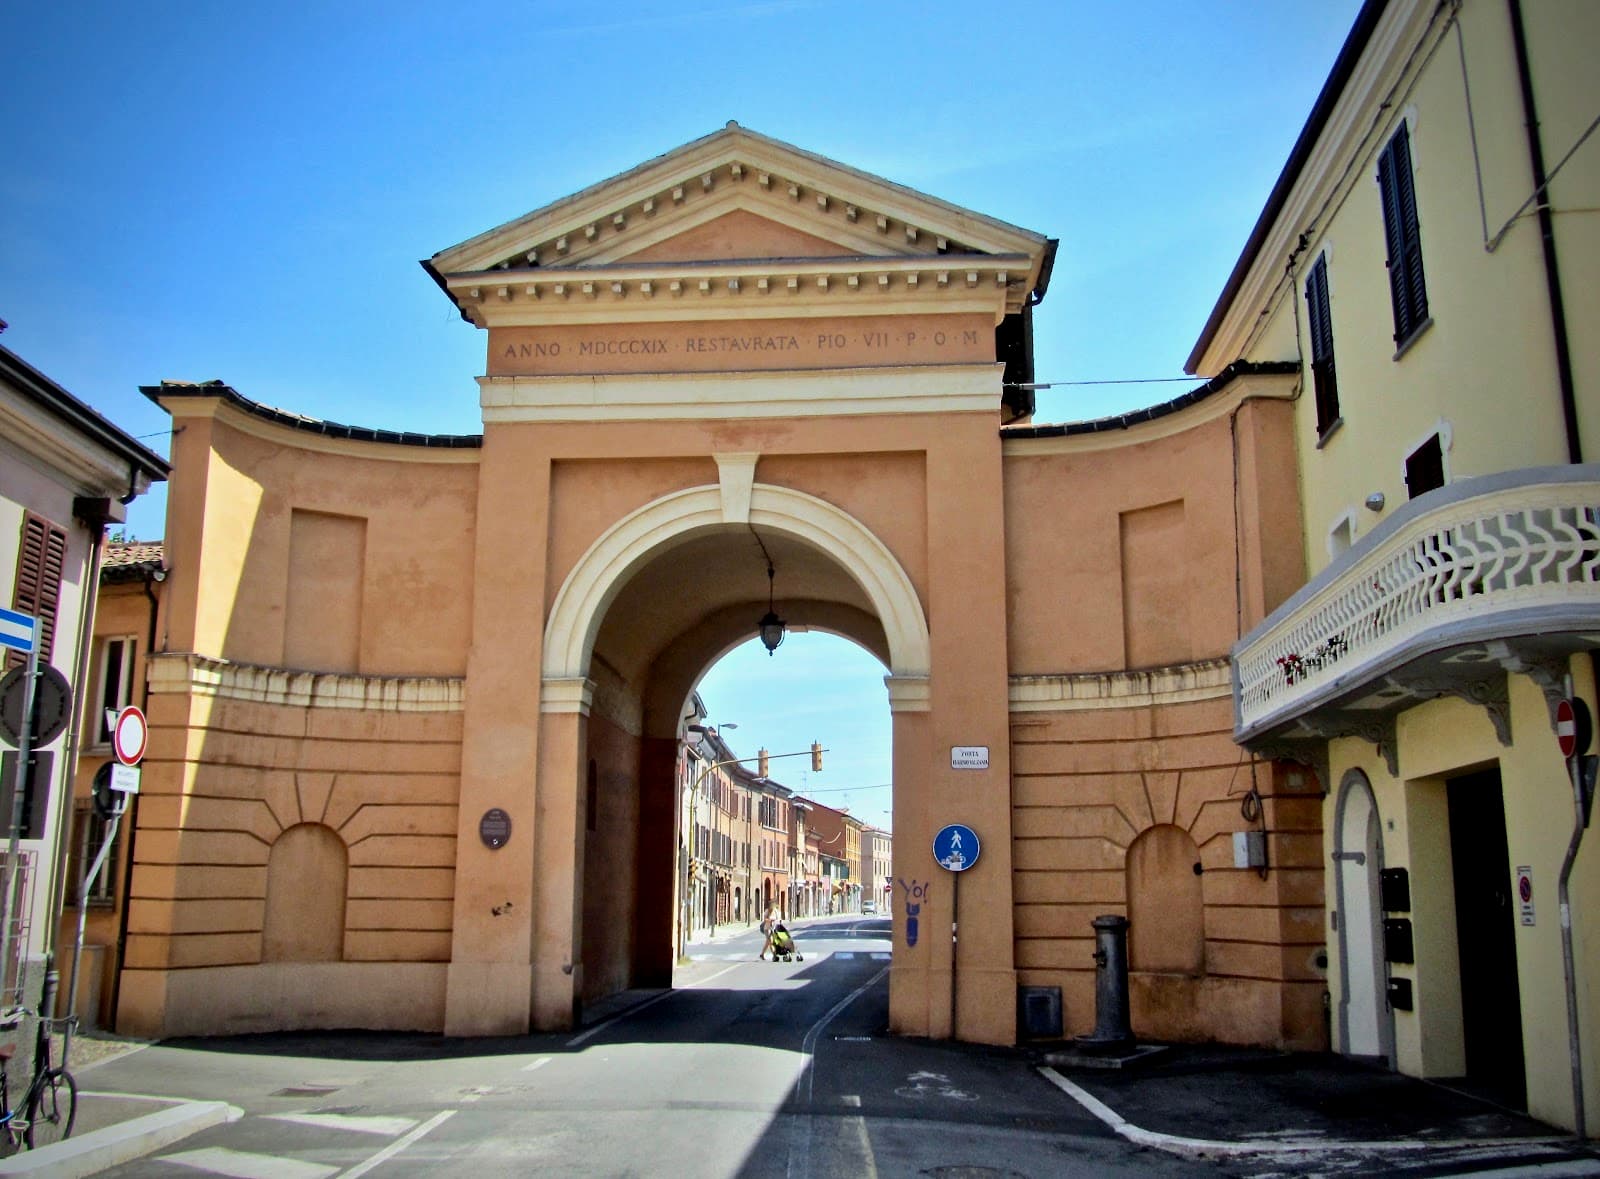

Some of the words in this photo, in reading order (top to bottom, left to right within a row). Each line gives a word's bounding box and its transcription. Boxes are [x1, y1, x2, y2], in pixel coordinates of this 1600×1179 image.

[504, 341, 561, 358] ANNO
[579, 338, 669, 356] MDCCCXIX
[686, 335, 800, 353] RESTAVRATA
[817, 333, 847, 349] PIO
[863, 332, 889, 347] VII
[906, 331, 917, 346] P
[934, 331, 947, 346] O
[962, 330, 978, 345] M
